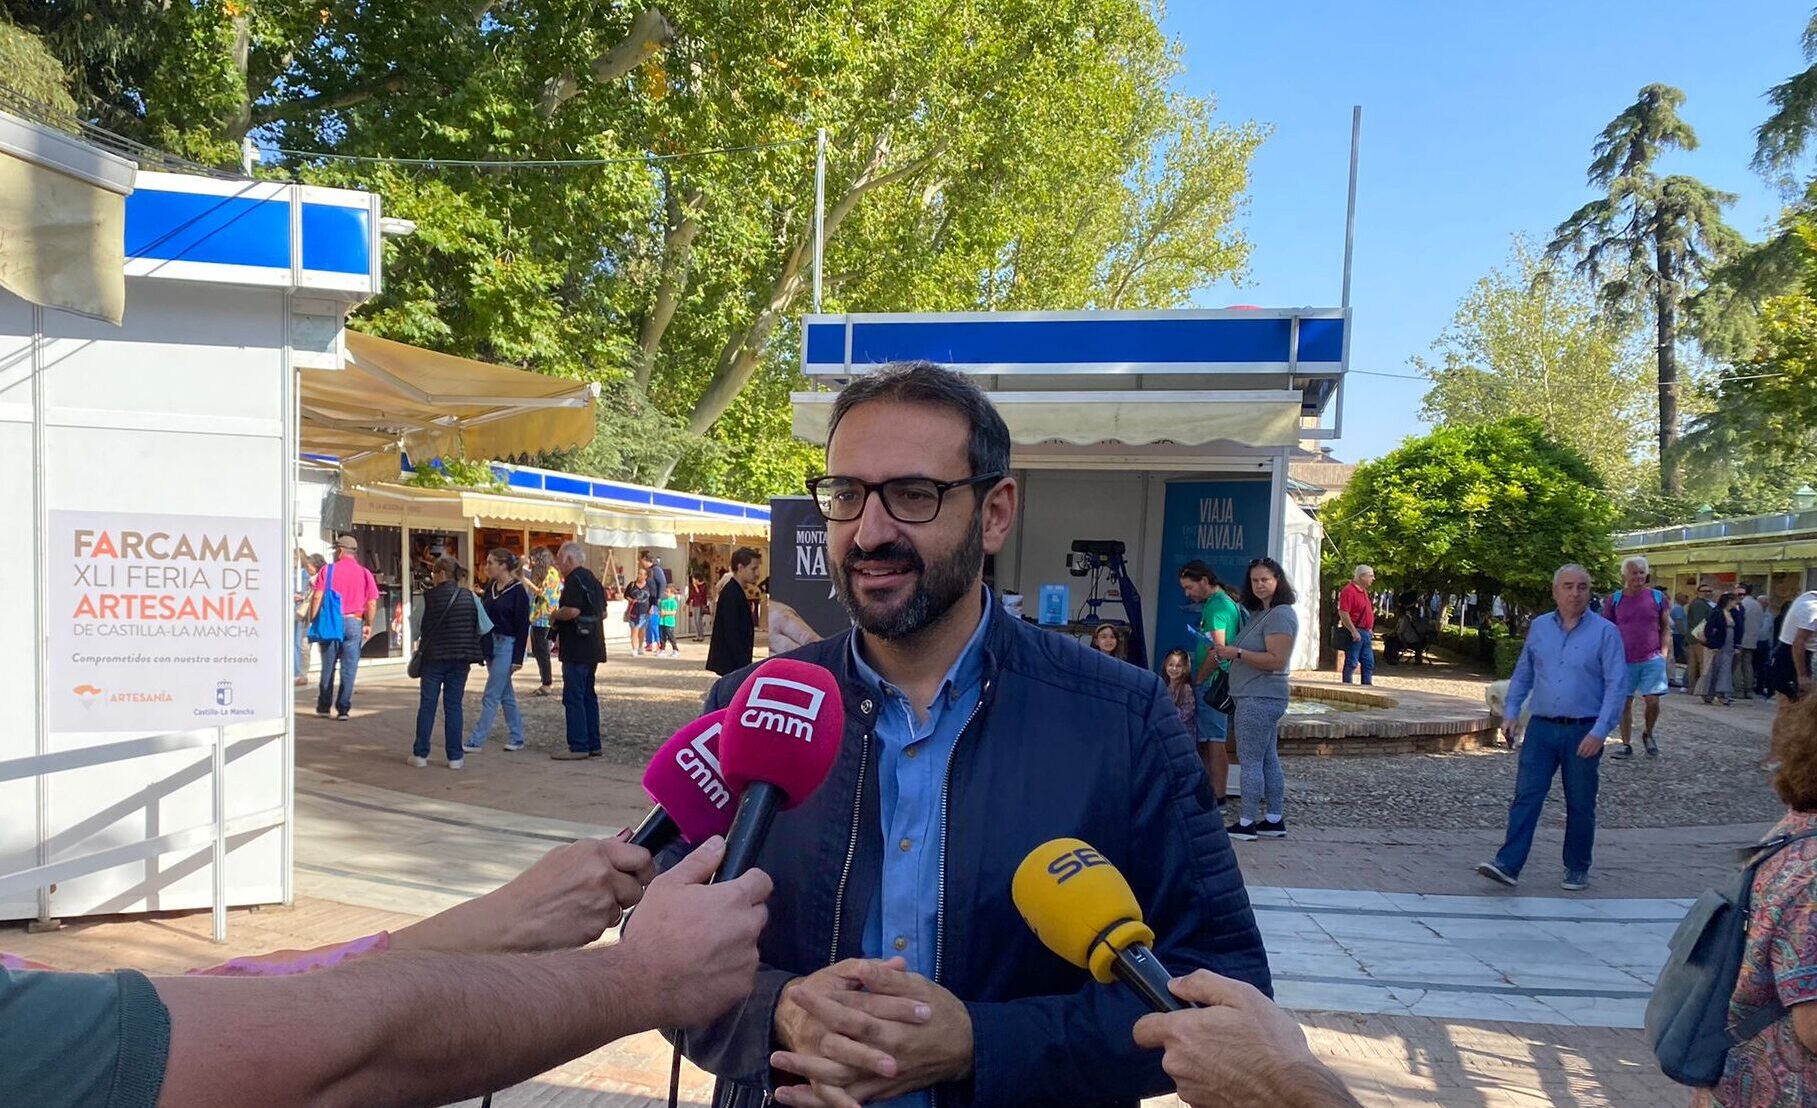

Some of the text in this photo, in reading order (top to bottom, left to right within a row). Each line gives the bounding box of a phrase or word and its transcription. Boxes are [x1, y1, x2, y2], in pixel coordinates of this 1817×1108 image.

[1200, 498, 1233, 523] VIAJA
[74, 529, 259, 562] FARCAMA
[1198, 525, 1244, 550] NAVAJA
[796, 545, 829, 576] NA
[74, 564, 260, 591] XLI FERIA DE
[73, 592, 260, 621] ARTESANÍA
[73, 623, 259, 639] DE CASTILLA-LA MANCHA
[71, 653, 151, 667] Comprometidos
[153, 656, 172, 665] con
[174, 655, 211, 665] nuestra
[110, 690, 174, 704] ARTESANÍA
[230, 707, 255, 716] Mancha
[740, 709, 814, 743] cmm
[675, 748, 730, 810] cmm
[1047, 847, 1109, 885] SE
